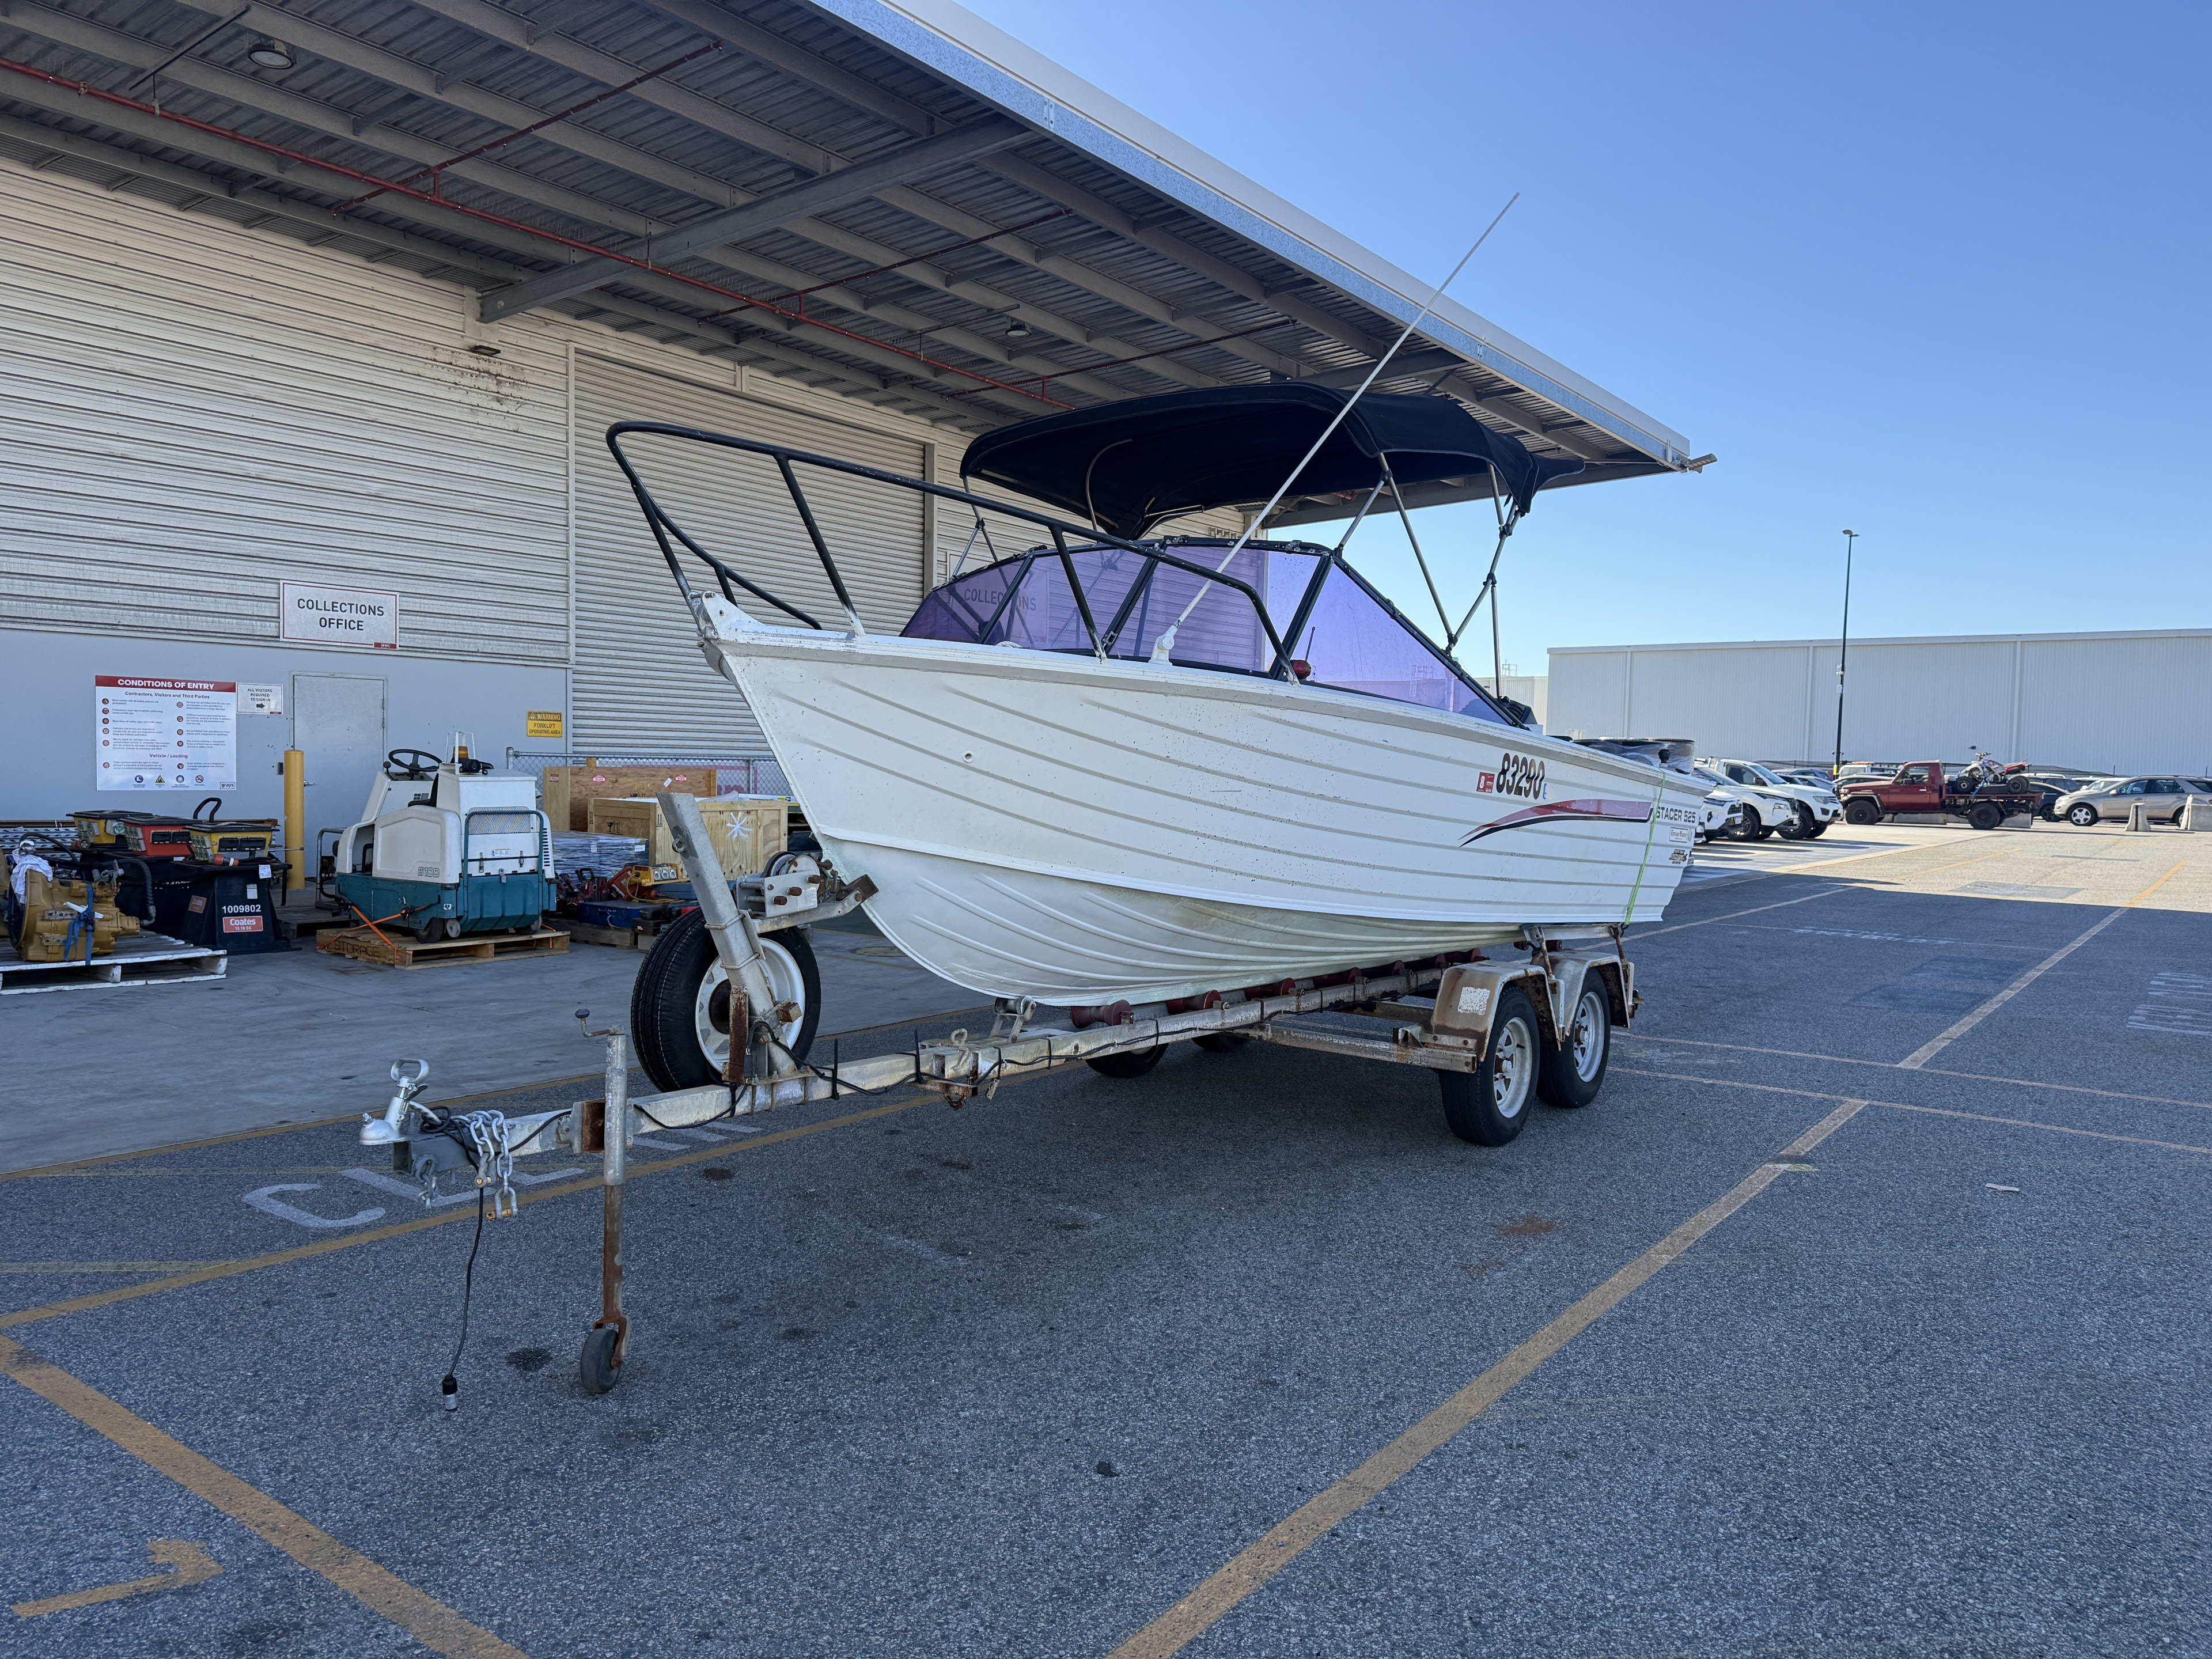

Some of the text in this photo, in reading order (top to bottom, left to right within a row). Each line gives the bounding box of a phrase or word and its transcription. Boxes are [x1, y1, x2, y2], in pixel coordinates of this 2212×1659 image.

[297, 598, 384, 616] COLLECTIONS
[319, 617, 364, 631] OFFICE
[118, 679, 173, 688] CONDITIONS
[1479, 775, 1485, 789] 8
[1496, 752, 1546, 800] 83290
[1656, 806, 1696, 823] STACER 525
[418, 866, 440, 877] 6100
[222, 904, 262, 914] 1009802
[334, 940, 380, 957] STORAGE
